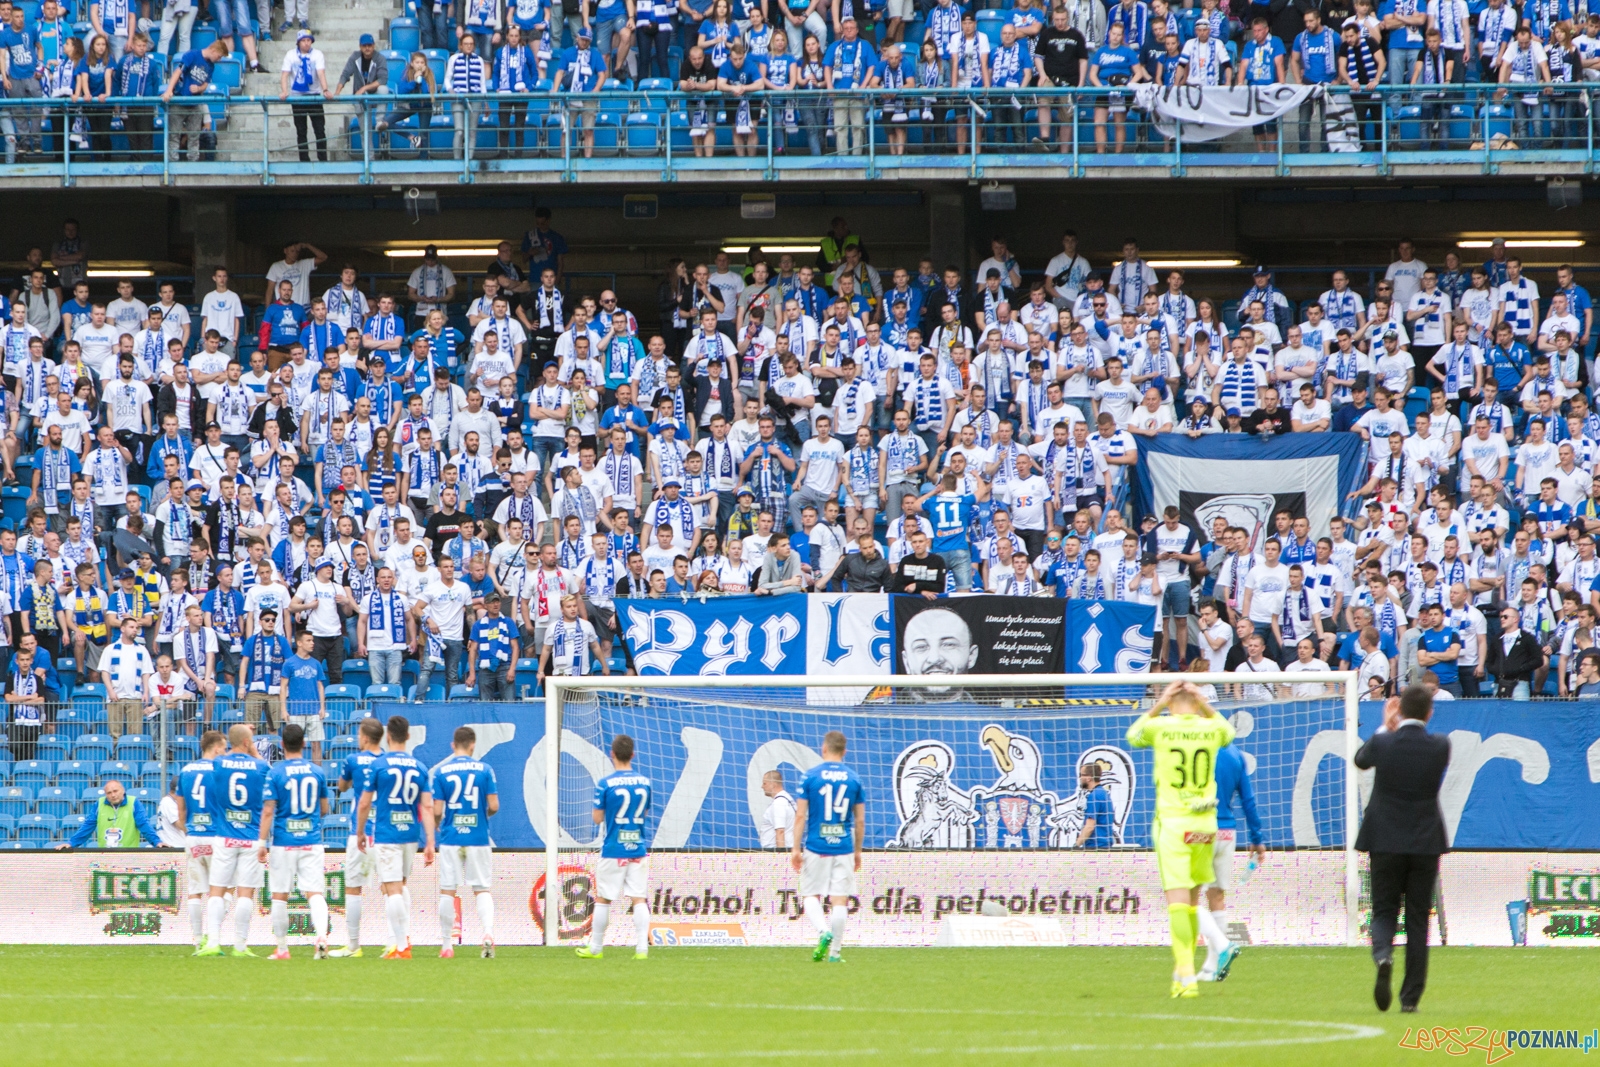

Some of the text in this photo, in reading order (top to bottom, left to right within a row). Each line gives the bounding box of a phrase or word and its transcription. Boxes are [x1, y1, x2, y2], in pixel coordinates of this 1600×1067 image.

[769, 66, 787, 81] 22
[634, 205, 648, 214] H2
[752, 204, 765, 213] G2
[116, 405, 136, 415] 2015
[1016, 496, 1034, 508] STS
[936, 502, 962, 528] 11
[724, 584, 746, 592] WARKA
[222, 759, 257, 770] TRAŁKA
[1170, 748, 1210, 789] 30
[821, 769, 848, 781] GAJOS
[191, 773, 206, 808] 4
[228, 772, 248, 806] 6
[284, 776, 319, 815] 10
[387, 768, 420, 805] 26
[446, 773, 480, 809] 24
[614, 788, 648, 825] 22
[819, 783, 850, 821] 14
[288, 821, 312, 830] LECH
[392, 813, 412, 822] LECH
[97, 876, 171, 899] LECH
[626, 888, 761, 916] lkohol.
[873, 887, 922, 915] dla
[934, 886, 1141, 920] pełnoletnich
[104, 912, 162, 936] PILS
[652, 928, 677, 946] STS
[682, 937, 744, 945] BUKMACHERSKIE
